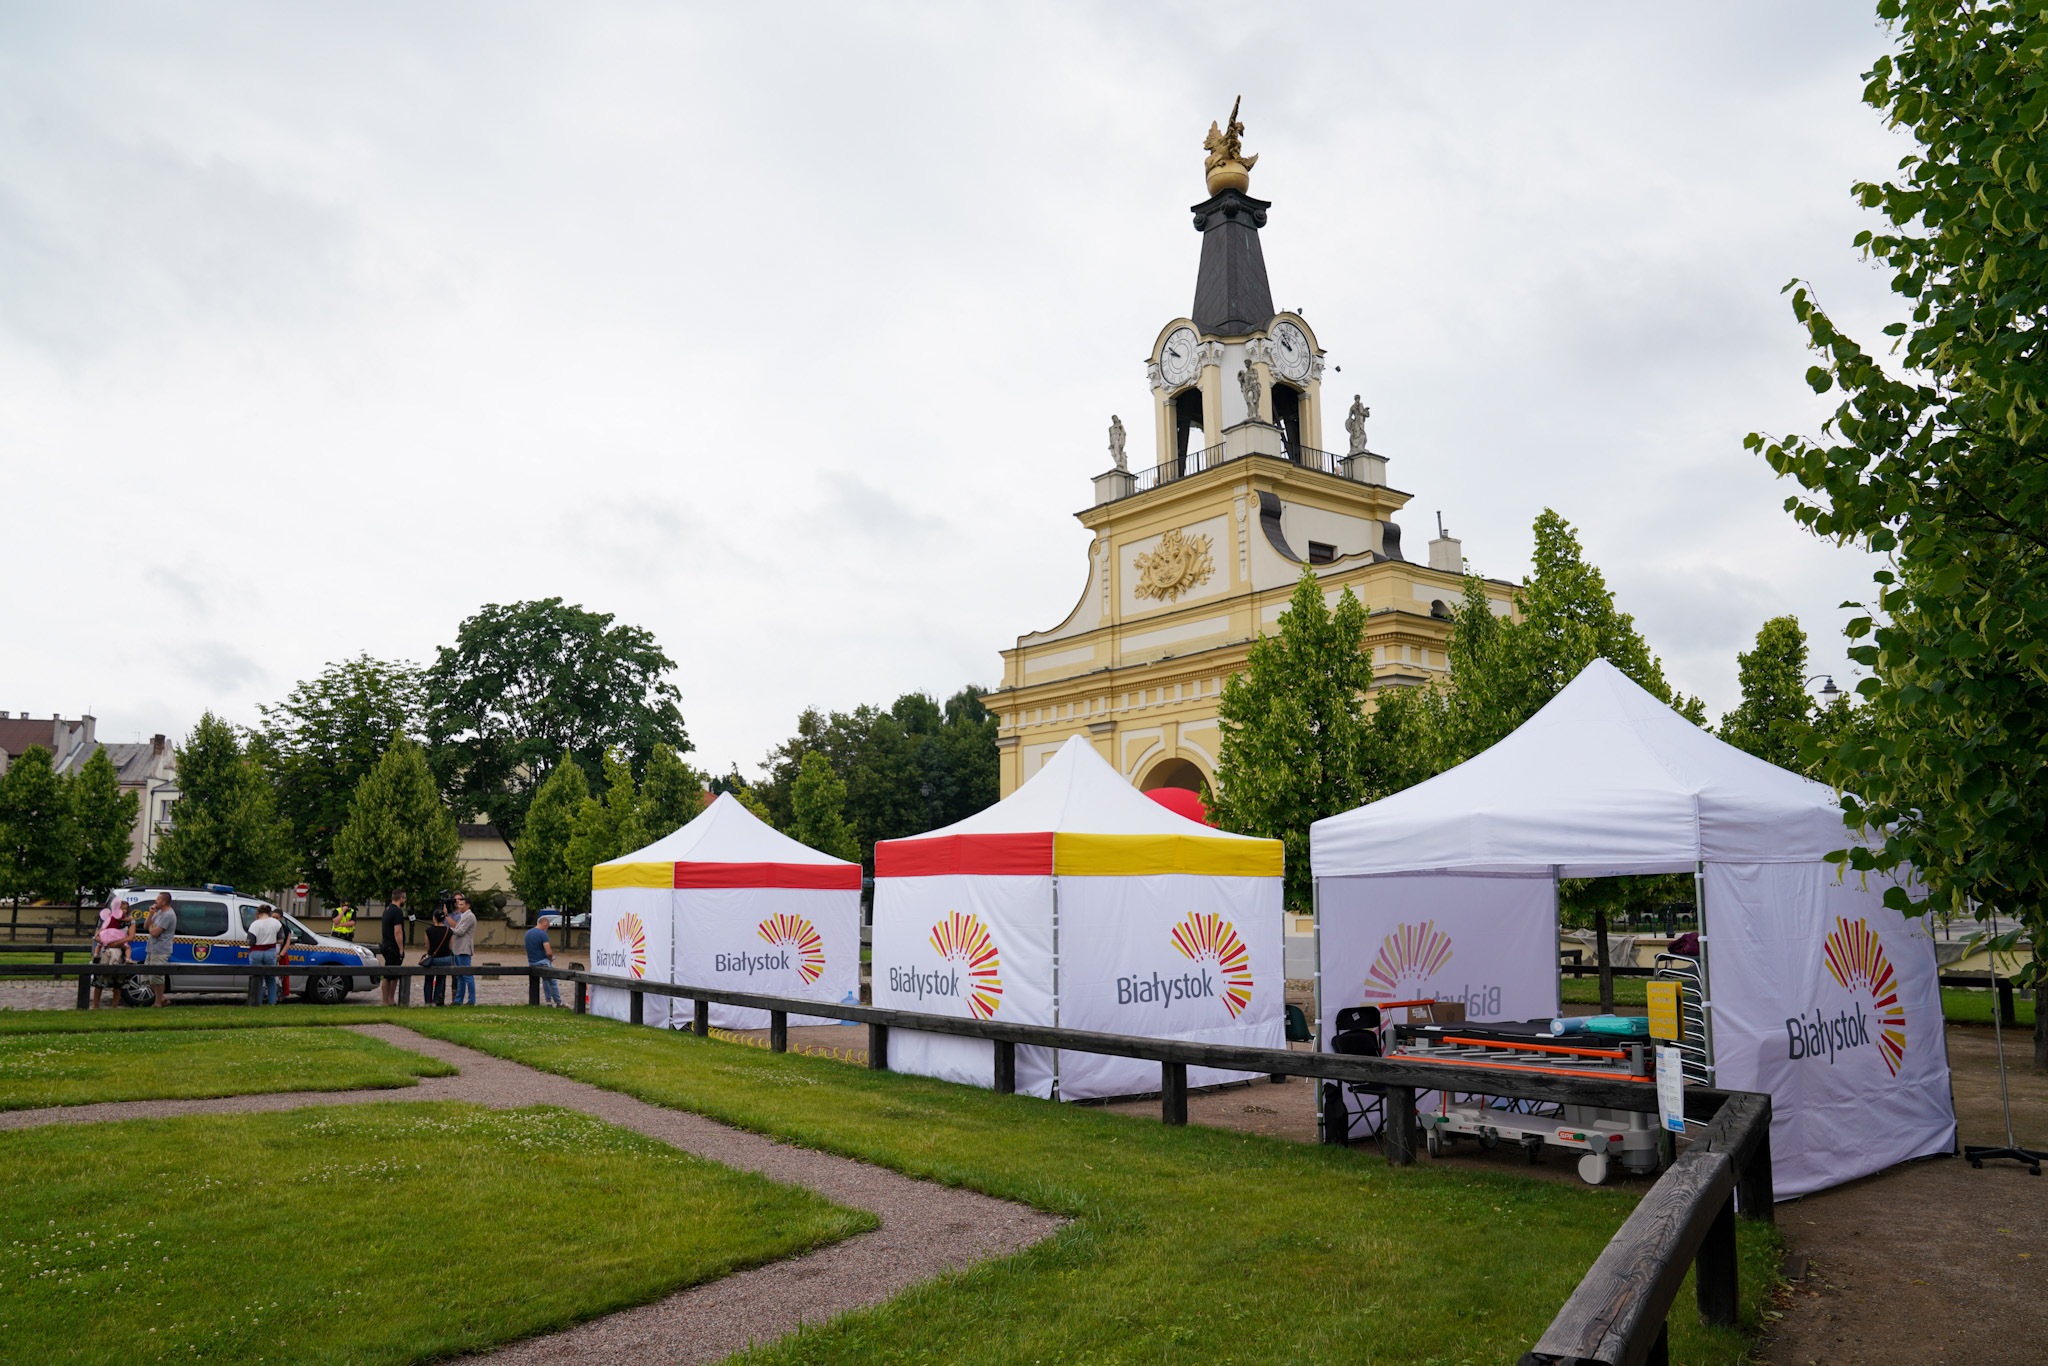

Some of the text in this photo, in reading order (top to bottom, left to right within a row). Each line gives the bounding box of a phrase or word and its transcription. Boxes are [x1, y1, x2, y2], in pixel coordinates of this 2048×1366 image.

[596, 948, 627, 971] Biaystok
[715, 950, 790, 976] Białystok
[890, 965, 960, 1001] Białystok
[1116, 968, 1214, 1009] Białystok
[1785, 1001, 1870, 1065] Białystok
